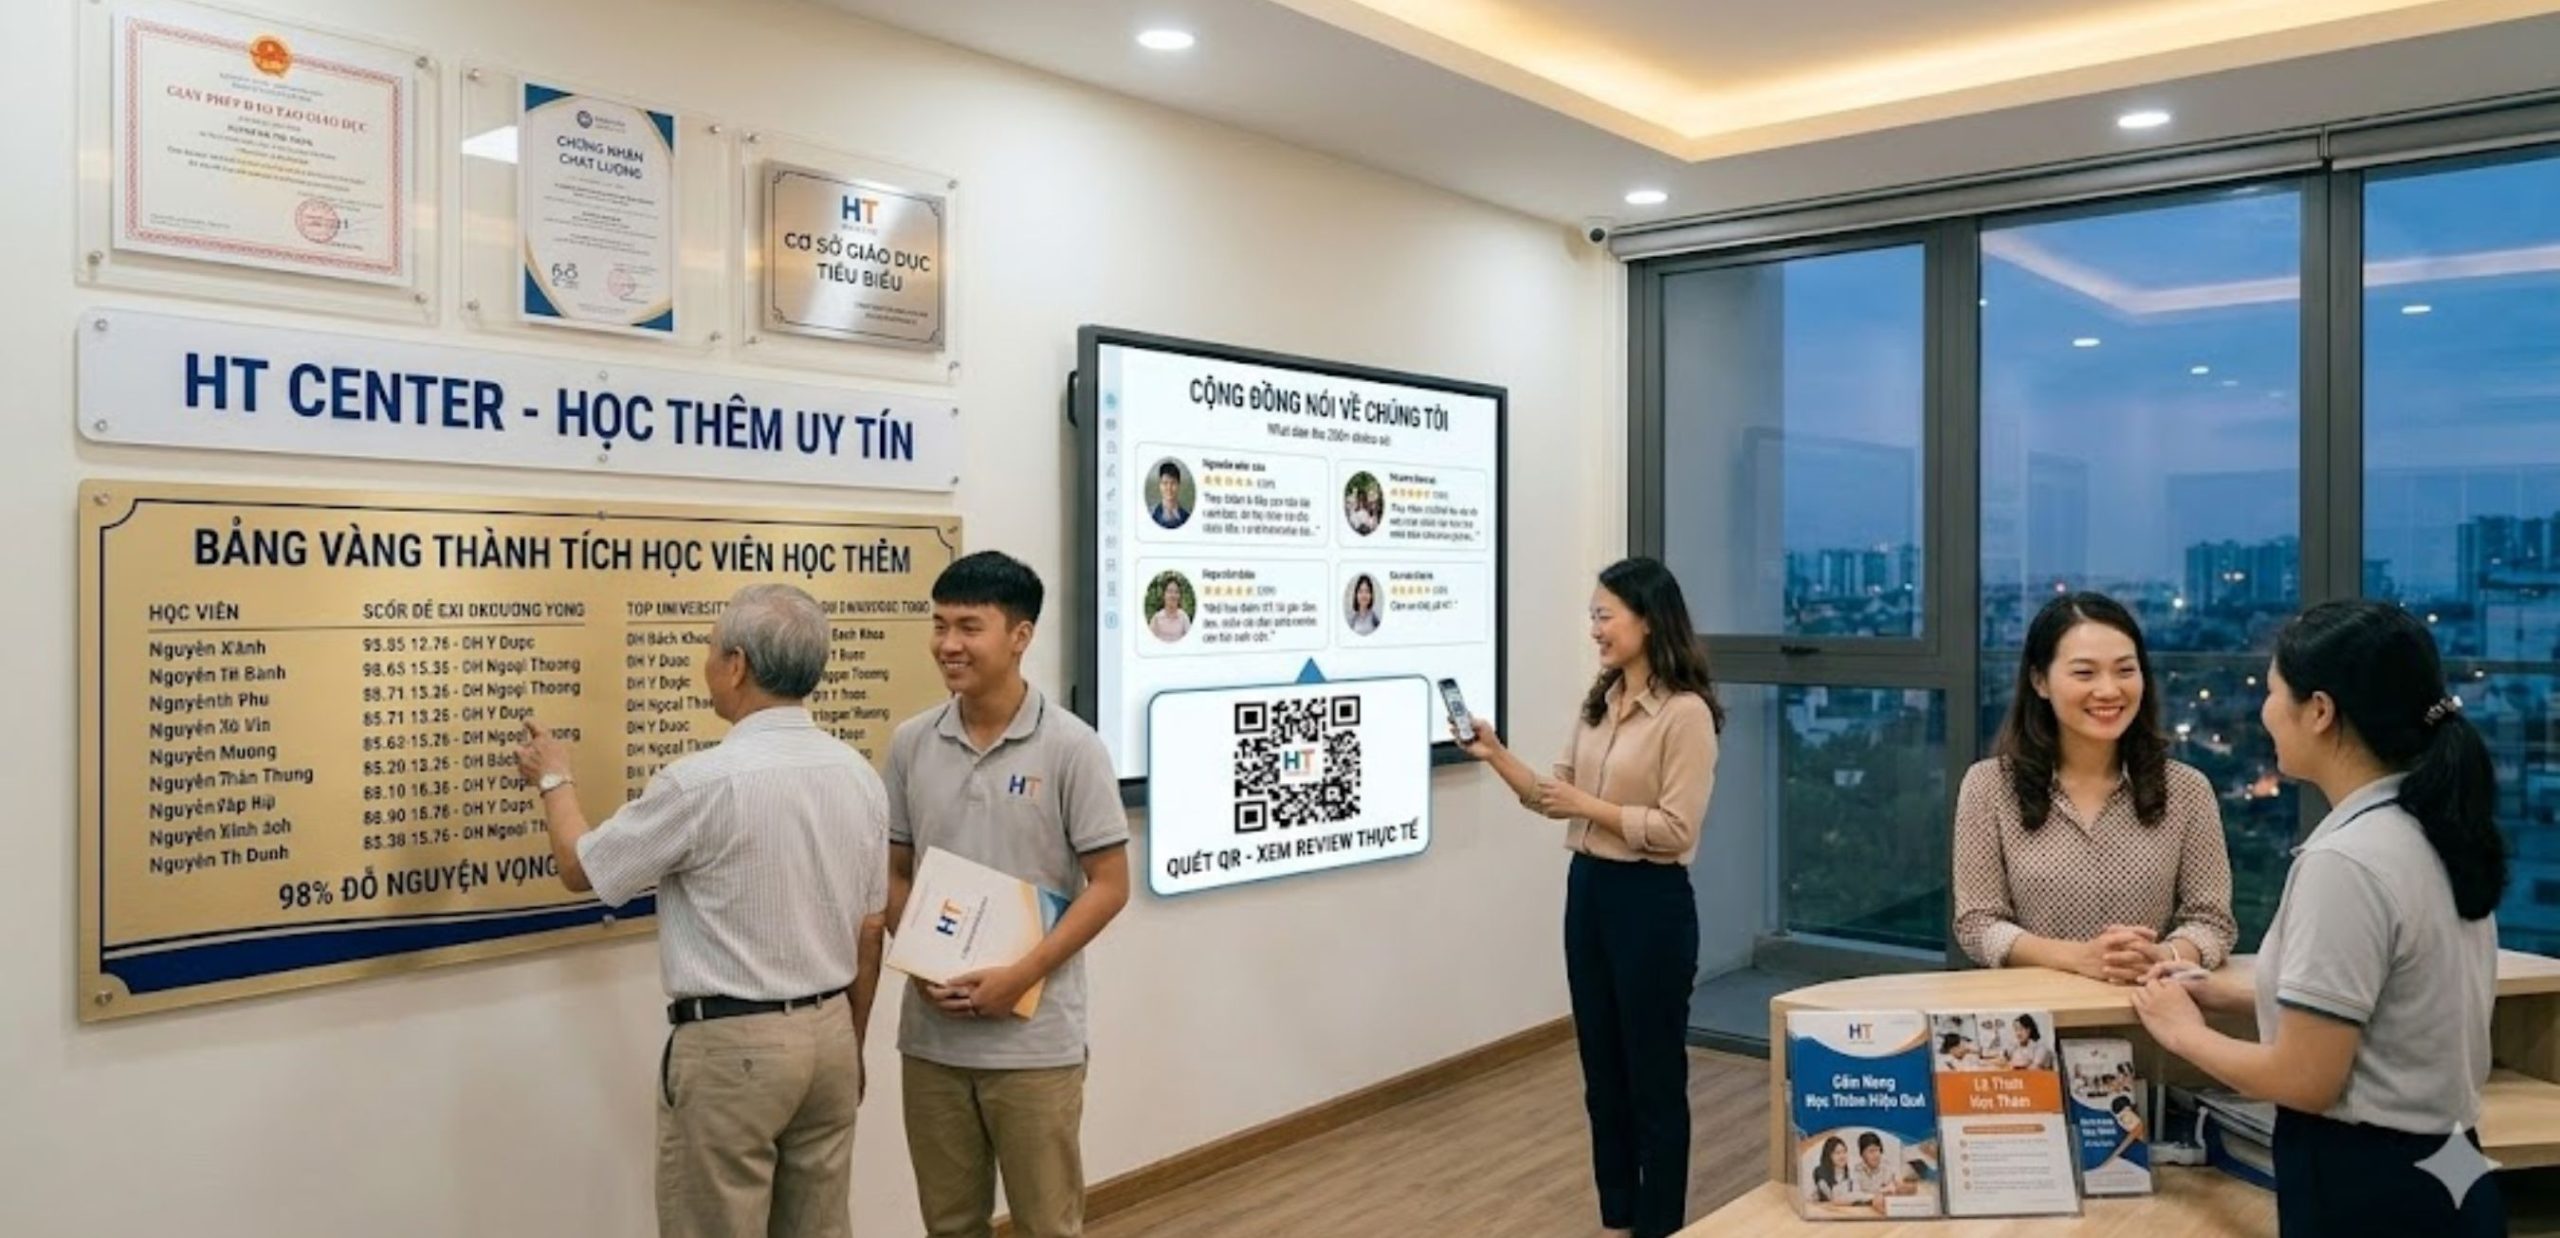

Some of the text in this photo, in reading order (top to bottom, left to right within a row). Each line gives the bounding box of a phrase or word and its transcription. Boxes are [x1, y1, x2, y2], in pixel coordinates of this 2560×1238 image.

[842, 196, 879, 224] HT
[184, 352, 914, 461] HT CENTER - HỌC THÊM UY TÍN
[193, 516, 306, 567] BẢNG
[319, 522, 422, 568] VÀNG
[433, 526, 551, 570] THÀNH
[560, 530, 633, 571] TÍCH
[642, 539, 703, 578] HỌC
[711, 534, 775, 573] VIÊN
[782, 542, 836, 580] HỌC
[149, 603, 189, 624] HỌC
[1283, 749, 1315, 771] HT
[1009, 774, 1043, 797] HT
[1217, 849, 1241, 871] QR
[1257, 843, 1292, 864] XEM
[1296, 832, 1353, 858] REVIEW
[278, 880, 334, 909] 98%
[386, 858, 489, 897] NGUYỆN
[1849, 1023, 1873, 1040] HT
